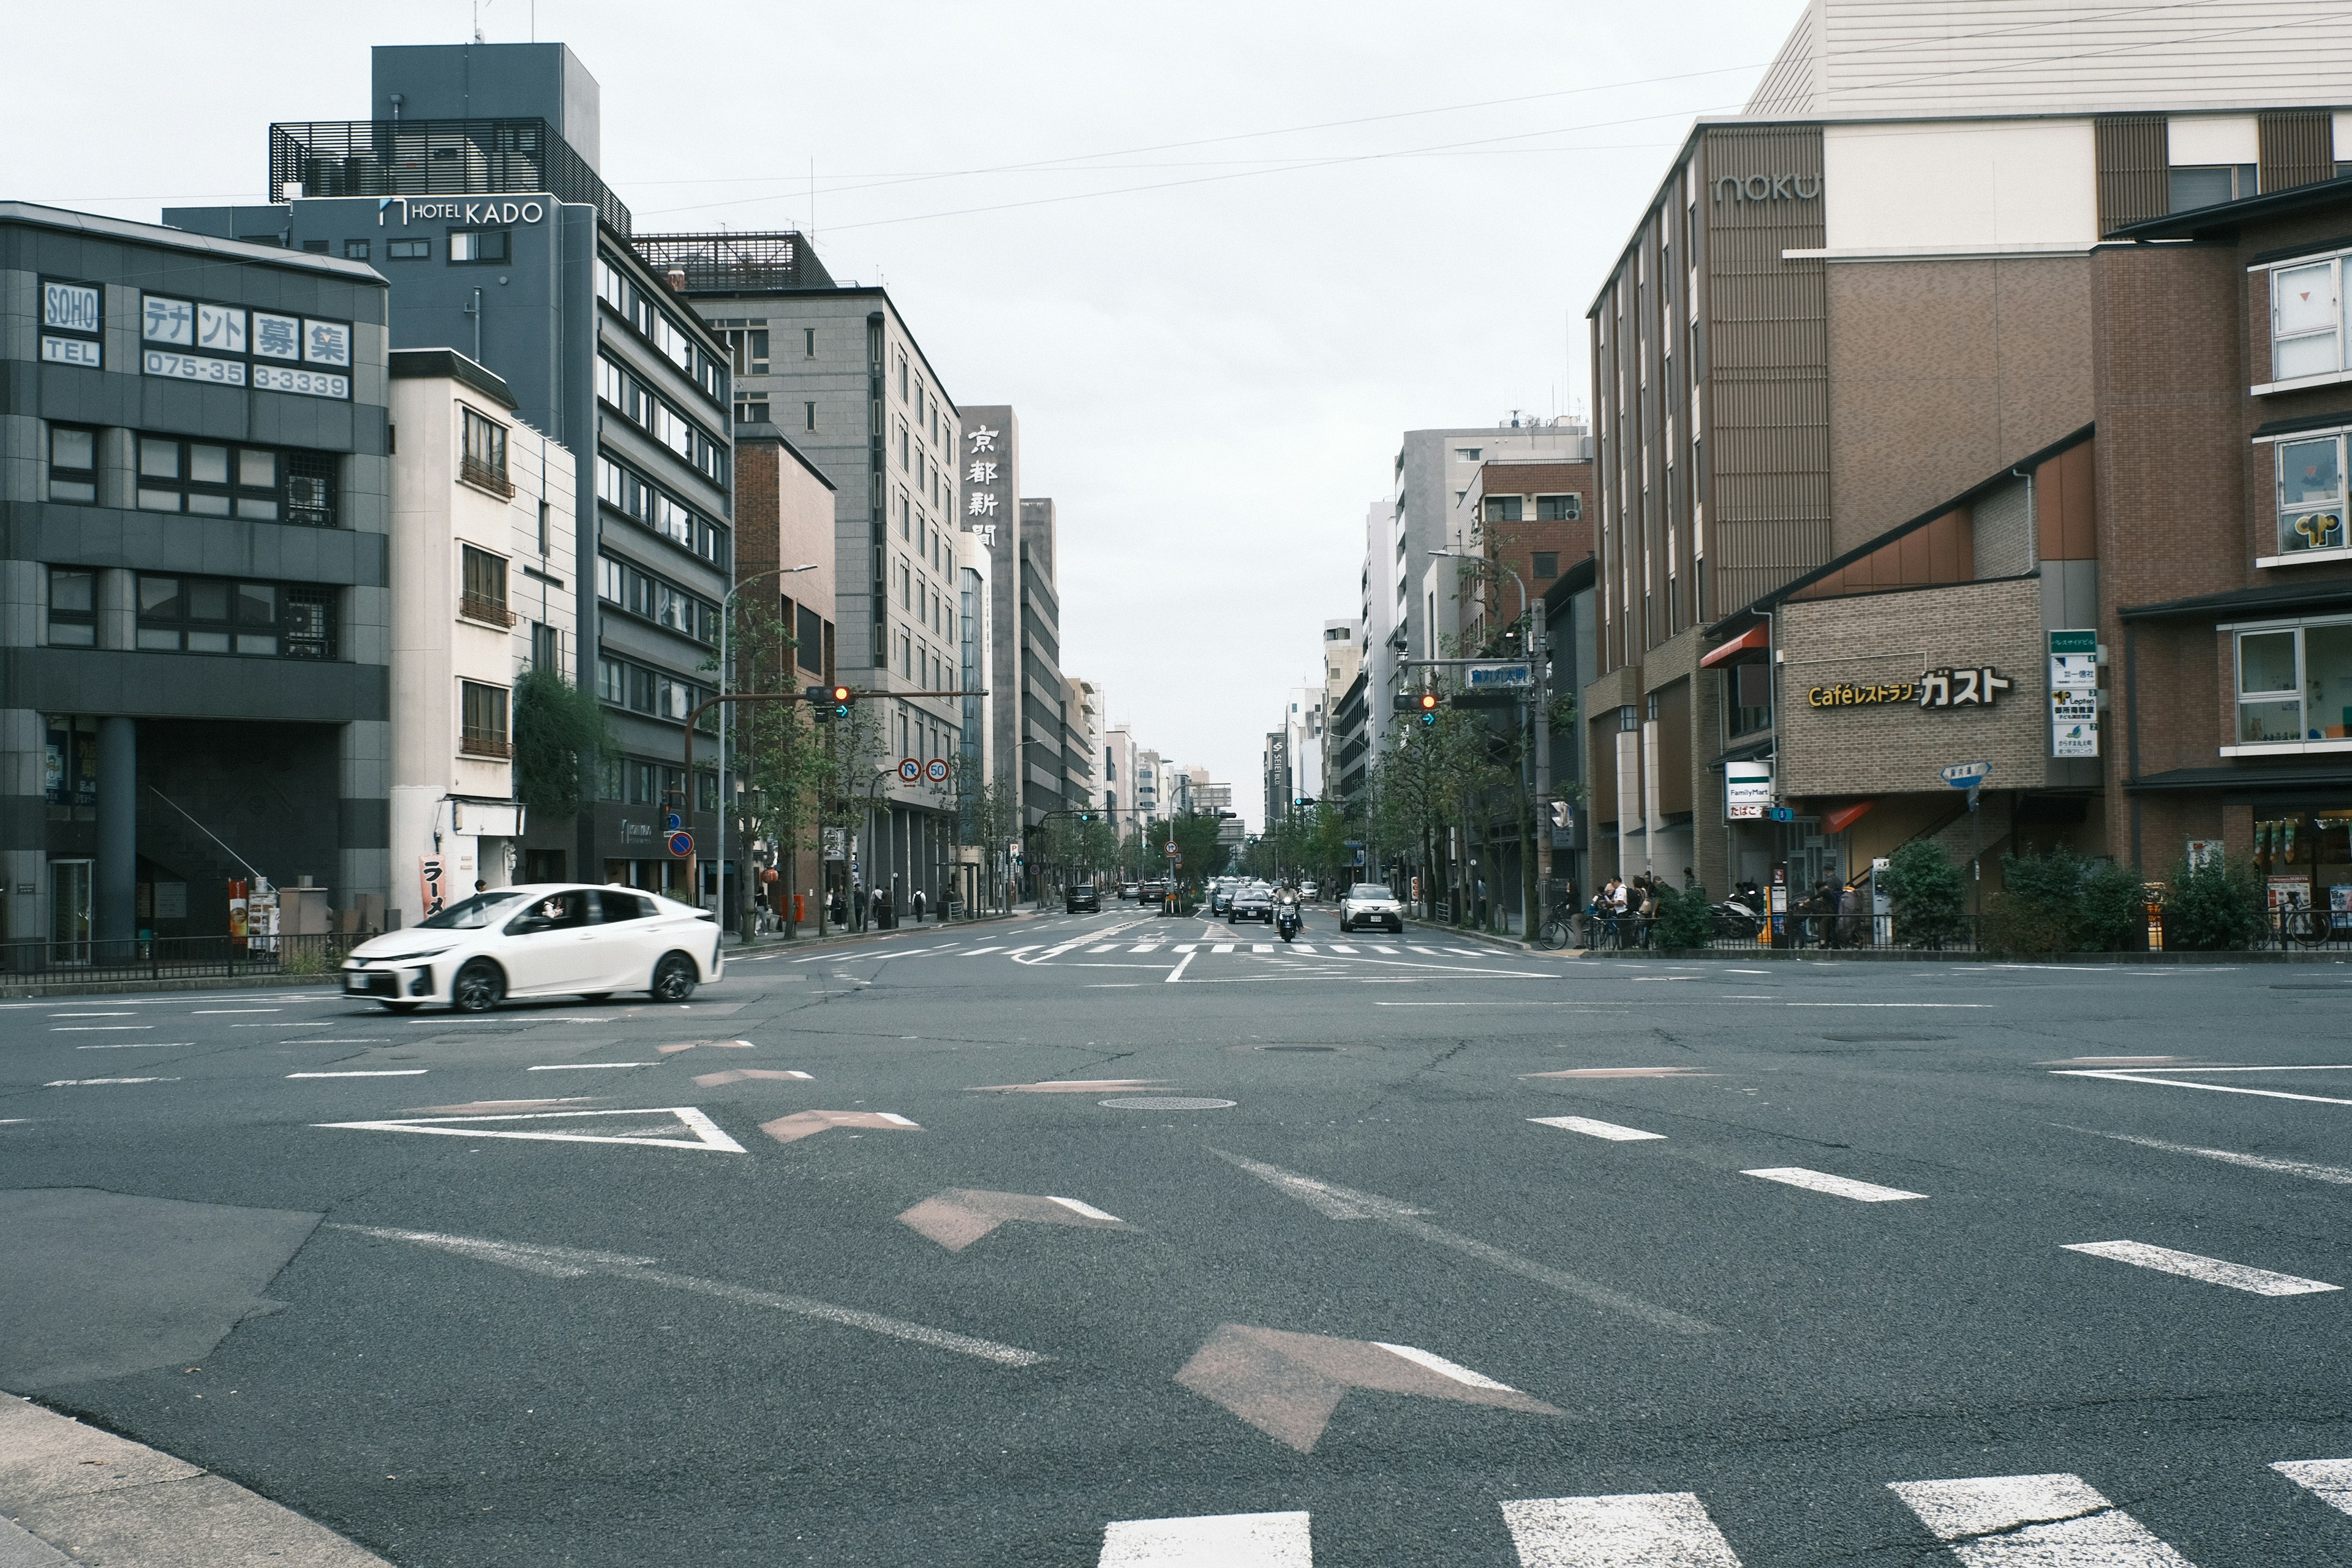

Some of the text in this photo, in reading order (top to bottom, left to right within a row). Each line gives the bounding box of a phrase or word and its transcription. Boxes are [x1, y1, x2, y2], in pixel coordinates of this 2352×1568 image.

[412, 202, 543, 224] HOTEL KADO
[47, 286, 95, 329] SOHO
[146, 301, 345, 362] テナント募集
[47, 339, 96, 363] TEL
[965, 424, 999, 547] 京都新聞
[1921, 668, 2009, 706] ガスト
[930, 765, 944, 776] 50
